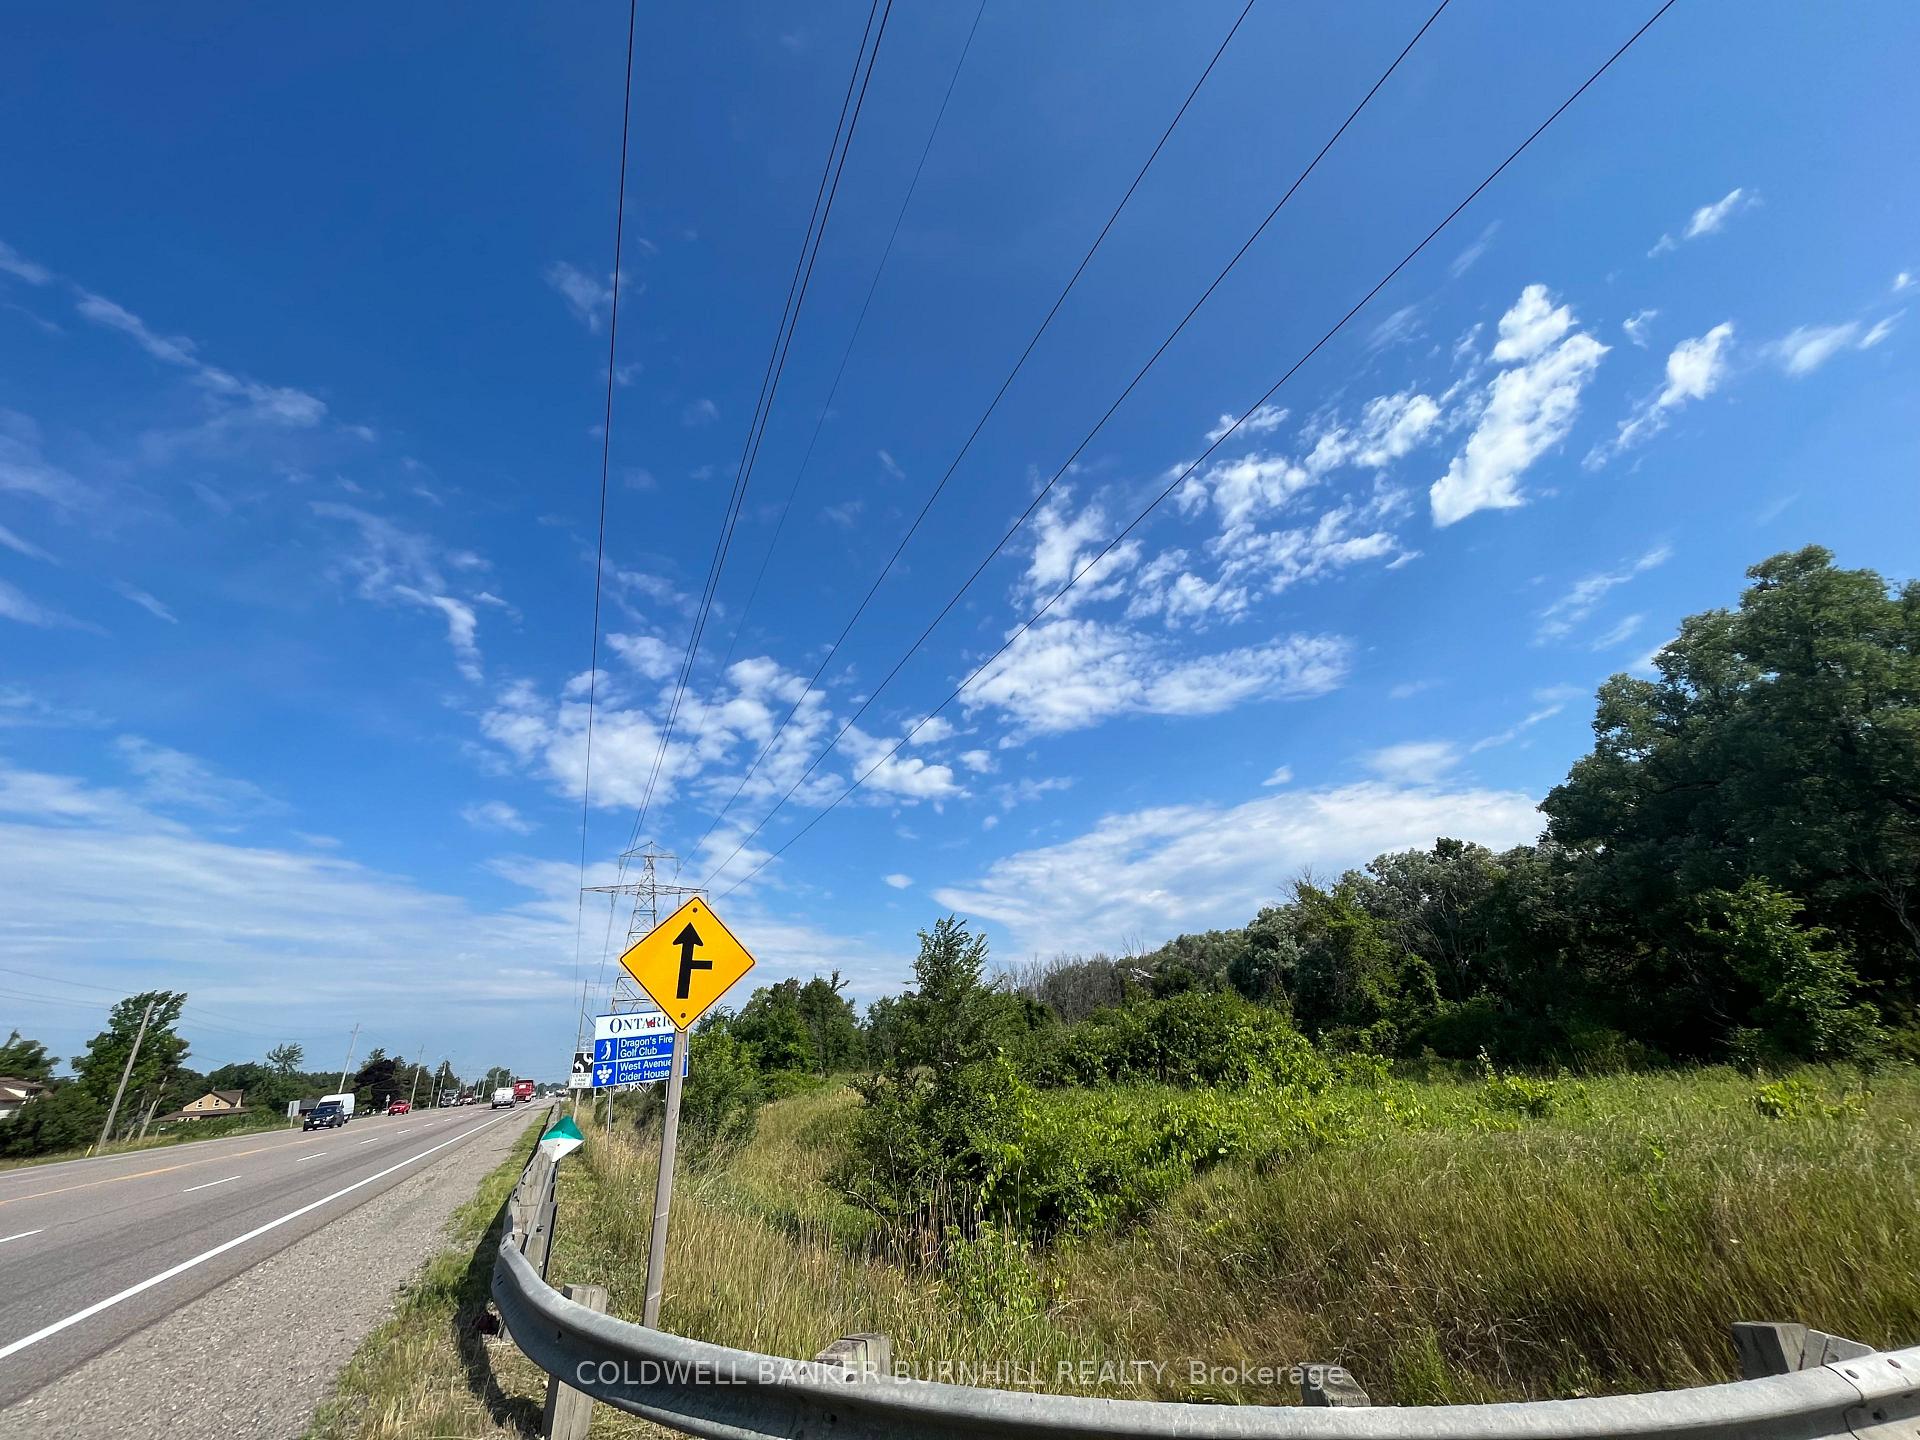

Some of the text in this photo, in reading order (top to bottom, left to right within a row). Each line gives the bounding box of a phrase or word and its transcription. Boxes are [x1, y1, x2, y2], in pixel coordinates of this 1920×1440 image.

[621, 1035, 673, 1049] Dragon's Fire
[620, 1047, 657, 1058] Golf Club
[620, 1059, 671, 1071] West Avenue
[619, 1069, 670, 1082] Cider House
